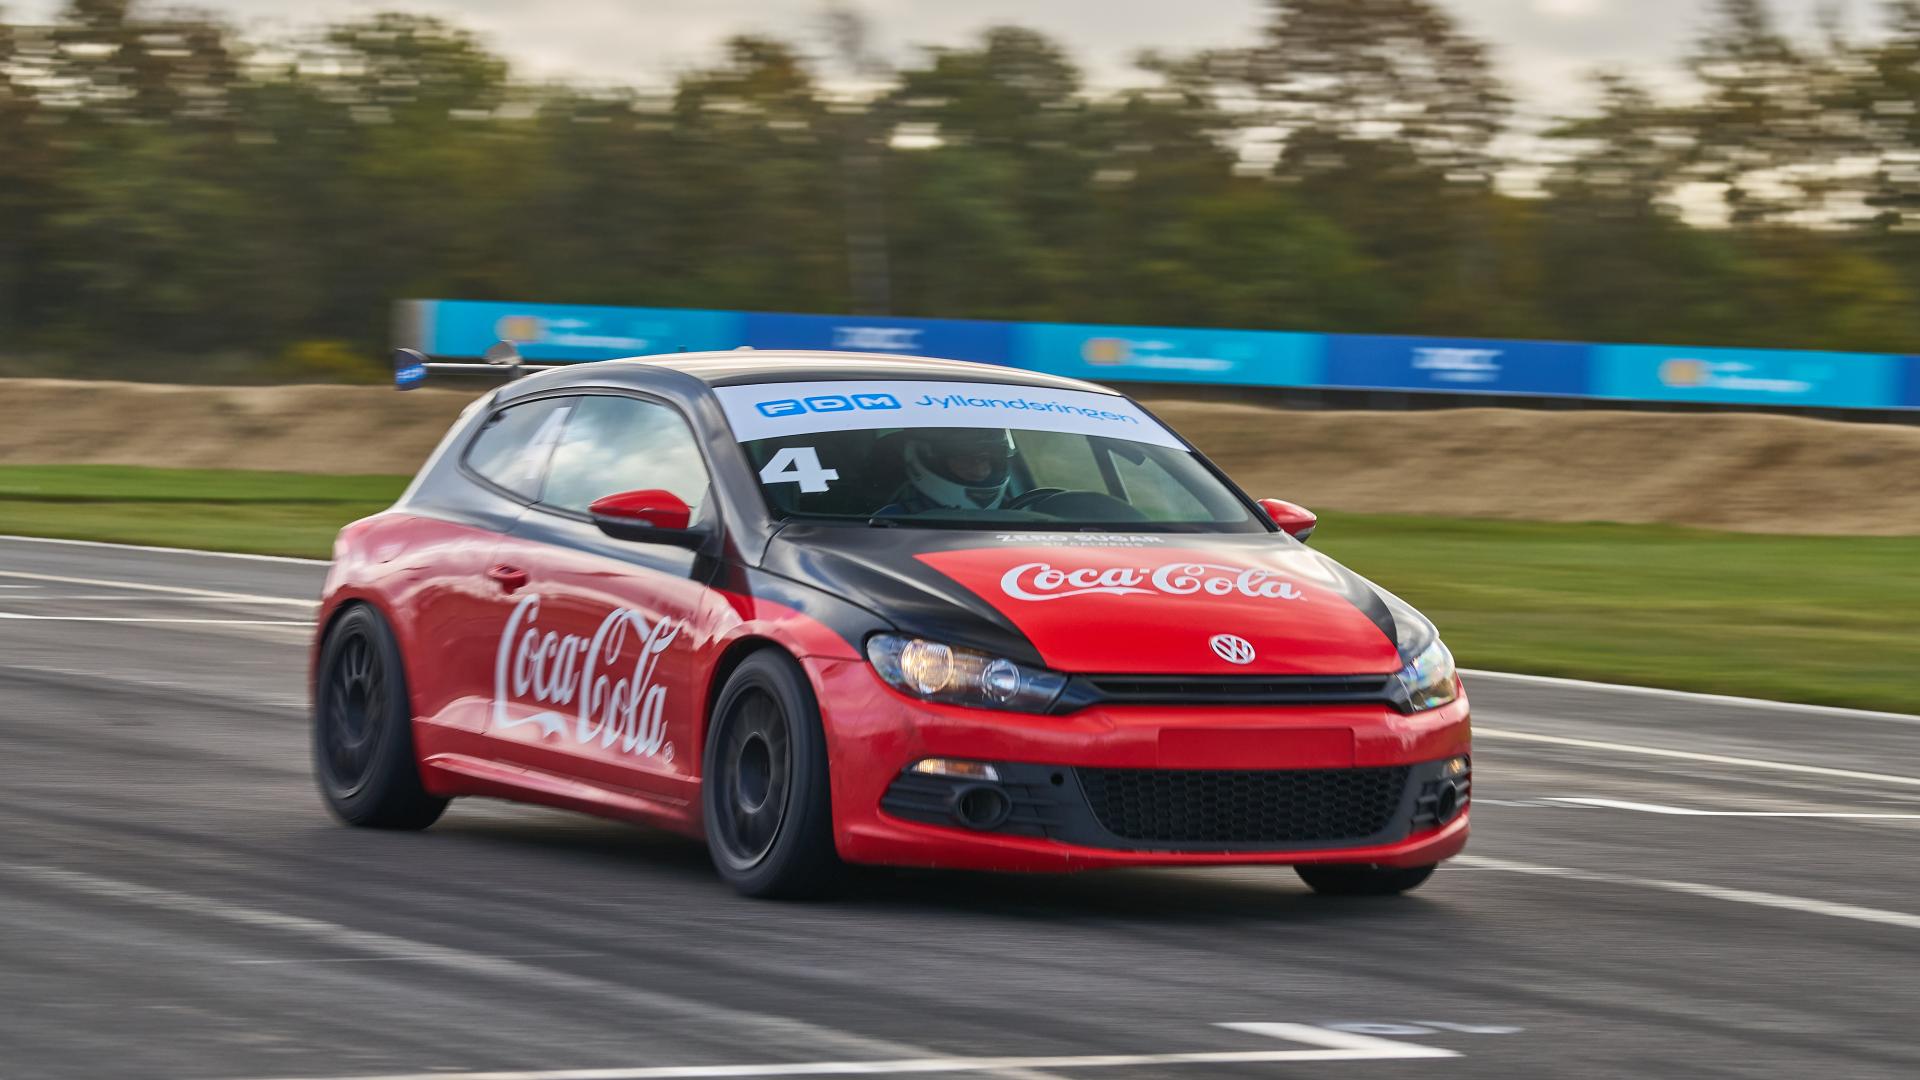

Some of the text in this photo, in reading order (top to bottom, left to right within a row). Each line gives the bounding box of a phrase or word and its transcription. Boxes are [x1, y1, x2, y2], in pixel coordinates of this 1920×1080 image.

[758, 394, 1138, 424] FDM Jyllandsringen
[758, 446, 840, 494] 4
[1000, 563, 1303, 601] Coca-Cola
[493, 594, 685, 757] Coca-Cola
